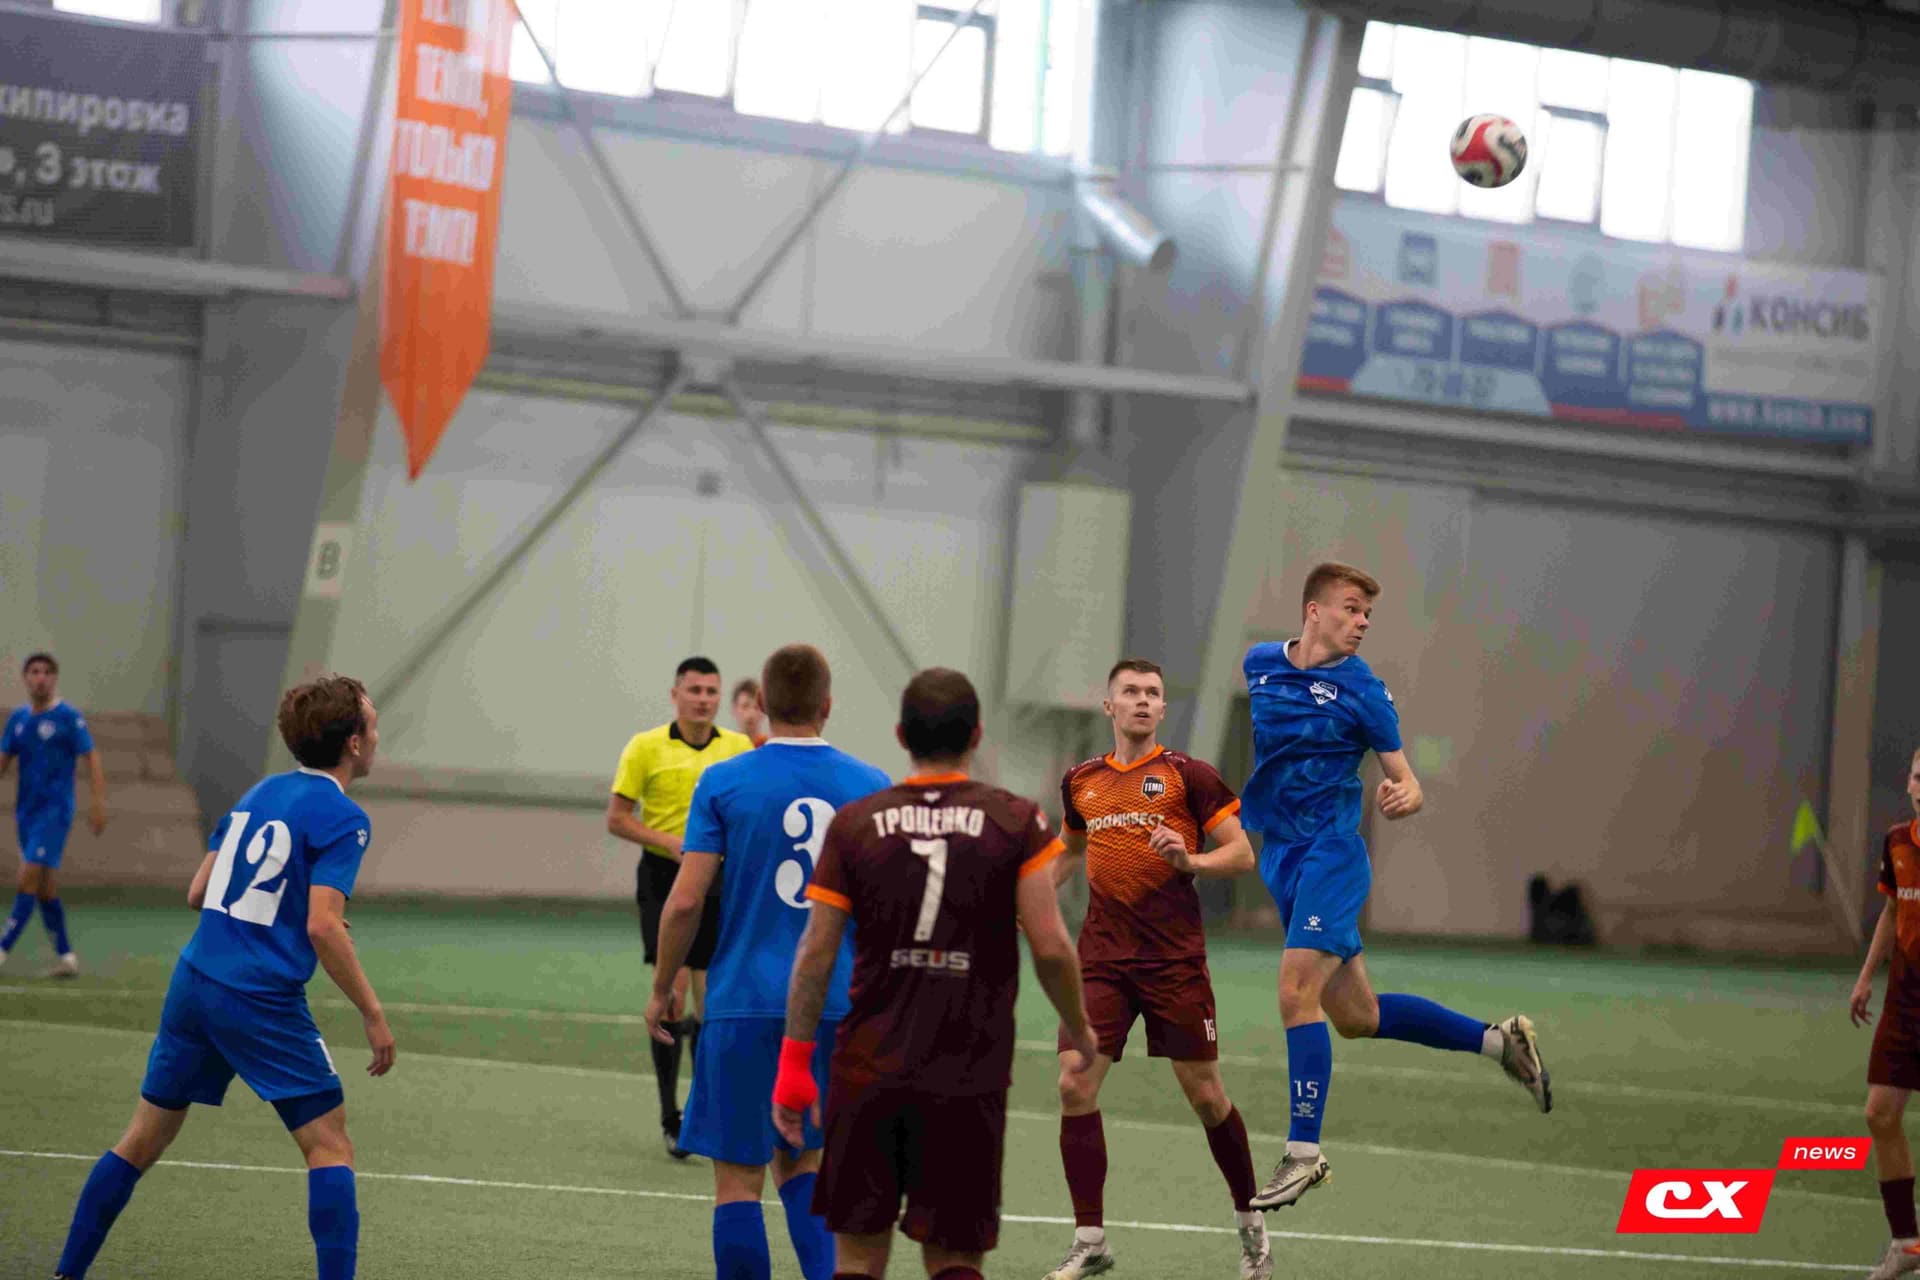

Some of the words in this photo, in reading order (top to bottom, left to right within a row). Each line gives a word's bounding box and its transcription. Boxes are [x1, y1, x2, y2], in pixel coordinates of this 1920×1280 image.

[35, 142, 63, 184] 3
[1749, 296, 1869, 341] КОНСИБ
[872, 805, 985, 838] ТРОЦЕНКО
[202, 811, 292, 927] 12
[775, 797, 836, 909] 3
[910, 838, 948, 942] 7
[1294, 1080, 1319, 1099] 15
